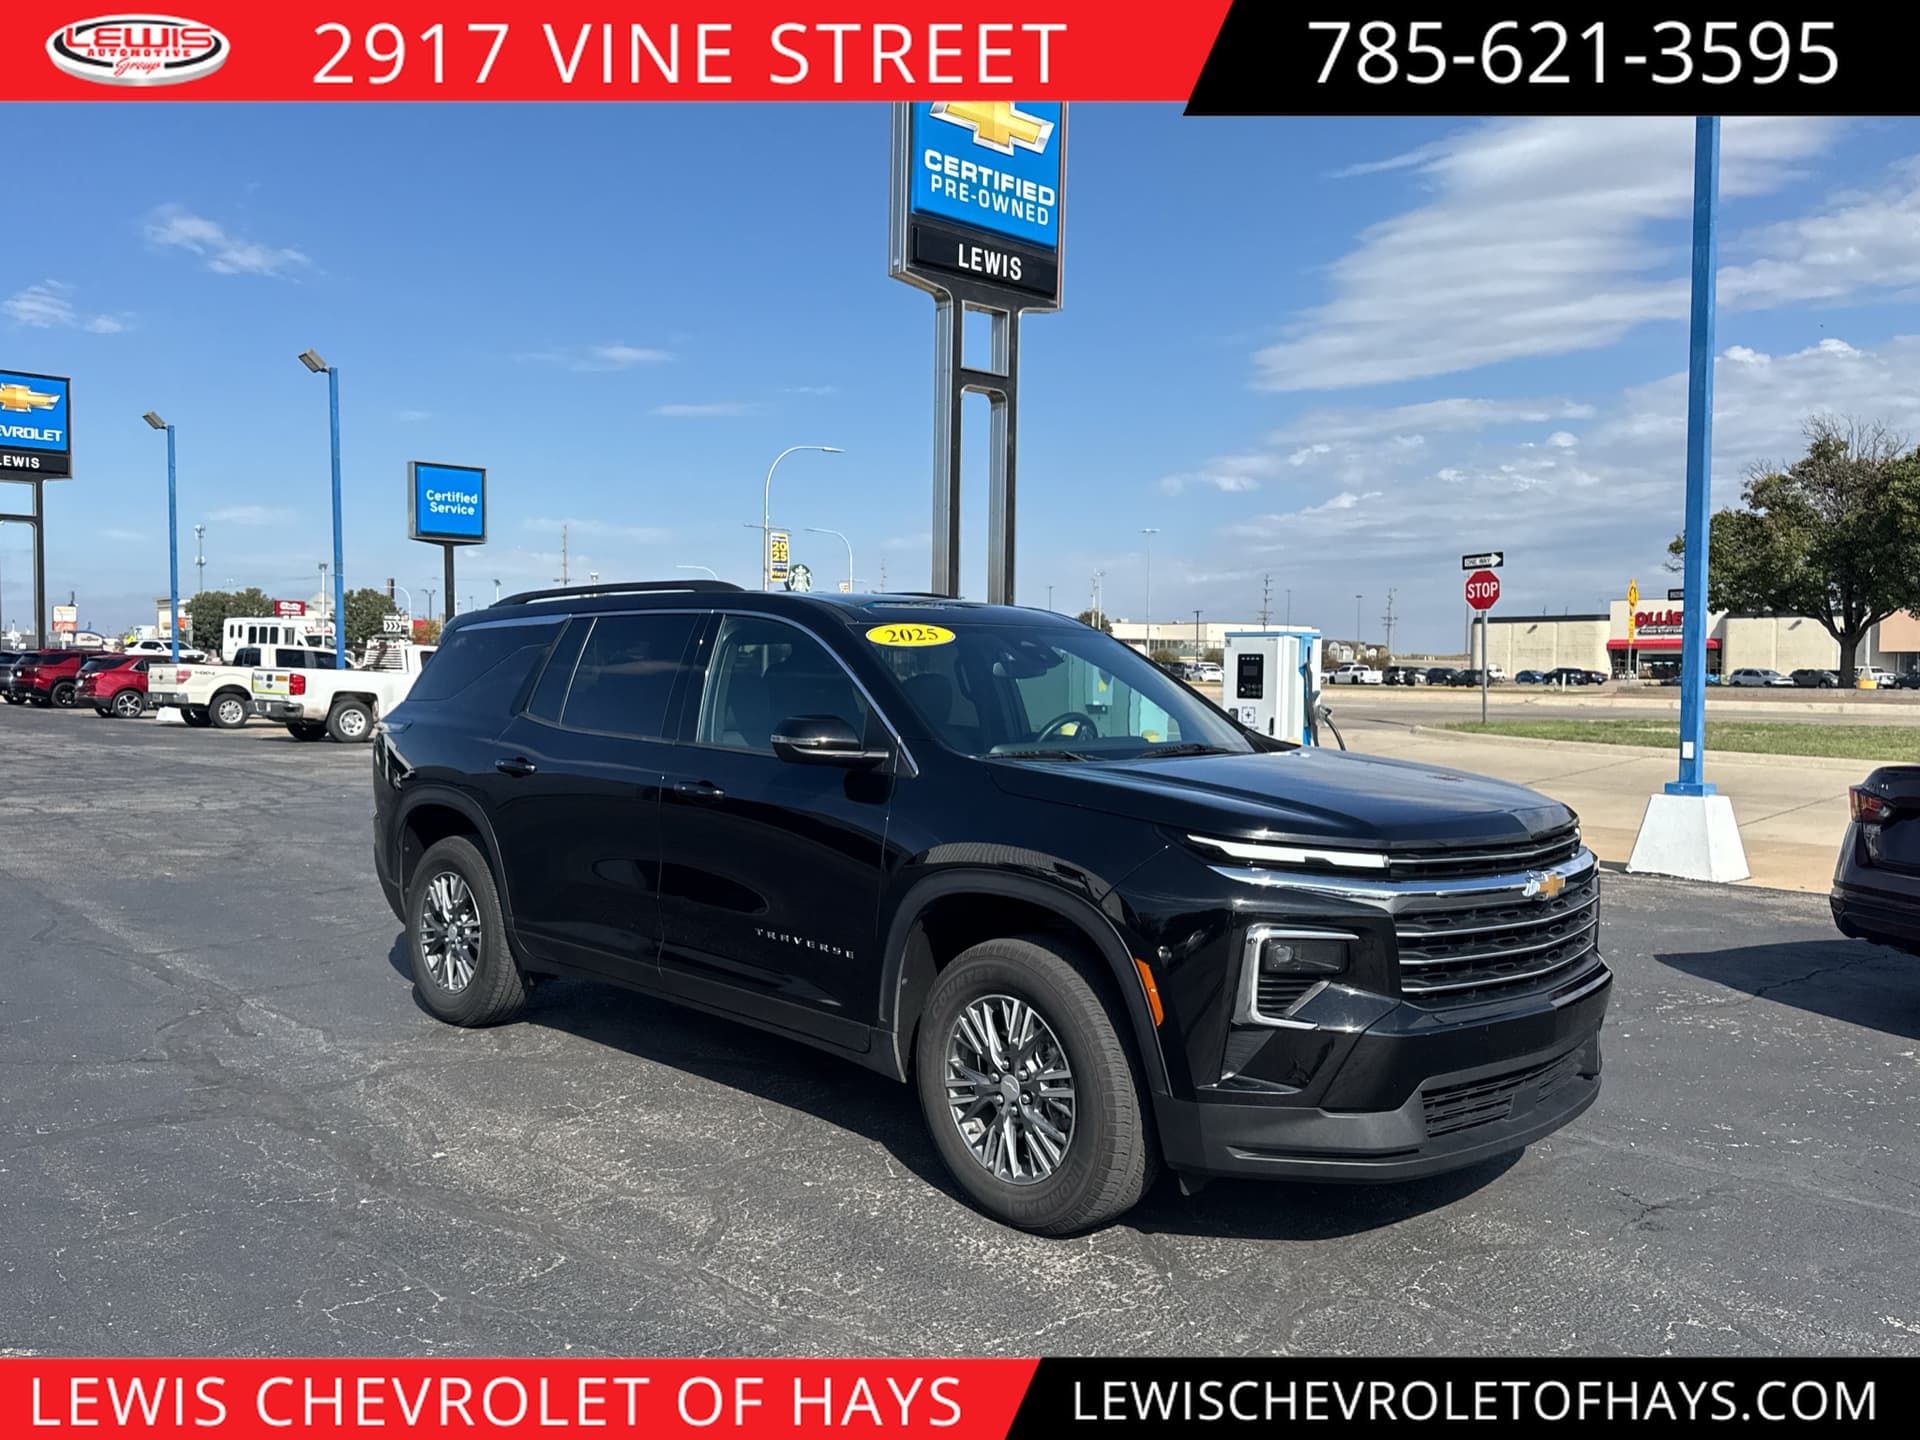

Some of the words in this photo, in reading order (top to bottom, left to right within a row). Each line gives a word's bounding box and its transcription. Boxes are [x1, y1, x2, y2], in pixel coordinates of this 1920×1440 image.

[924, 149, 1055, 207] CERTIFIED
[931, 174, 1049, 226] PRE-OWNED
[958, 243, 1022, 281] LEWIS
[0, 425, 63, 442] VROLET
[0, 455, 40, 469] EWIS
[426, 489, 478, 504] Certified
[430, 501, 475, 515] Service
[1467, 582, 1498, 599] STOP
[884, 628, 938, 642] 2025
[754, 927, 855, 960] TRAVERSE
